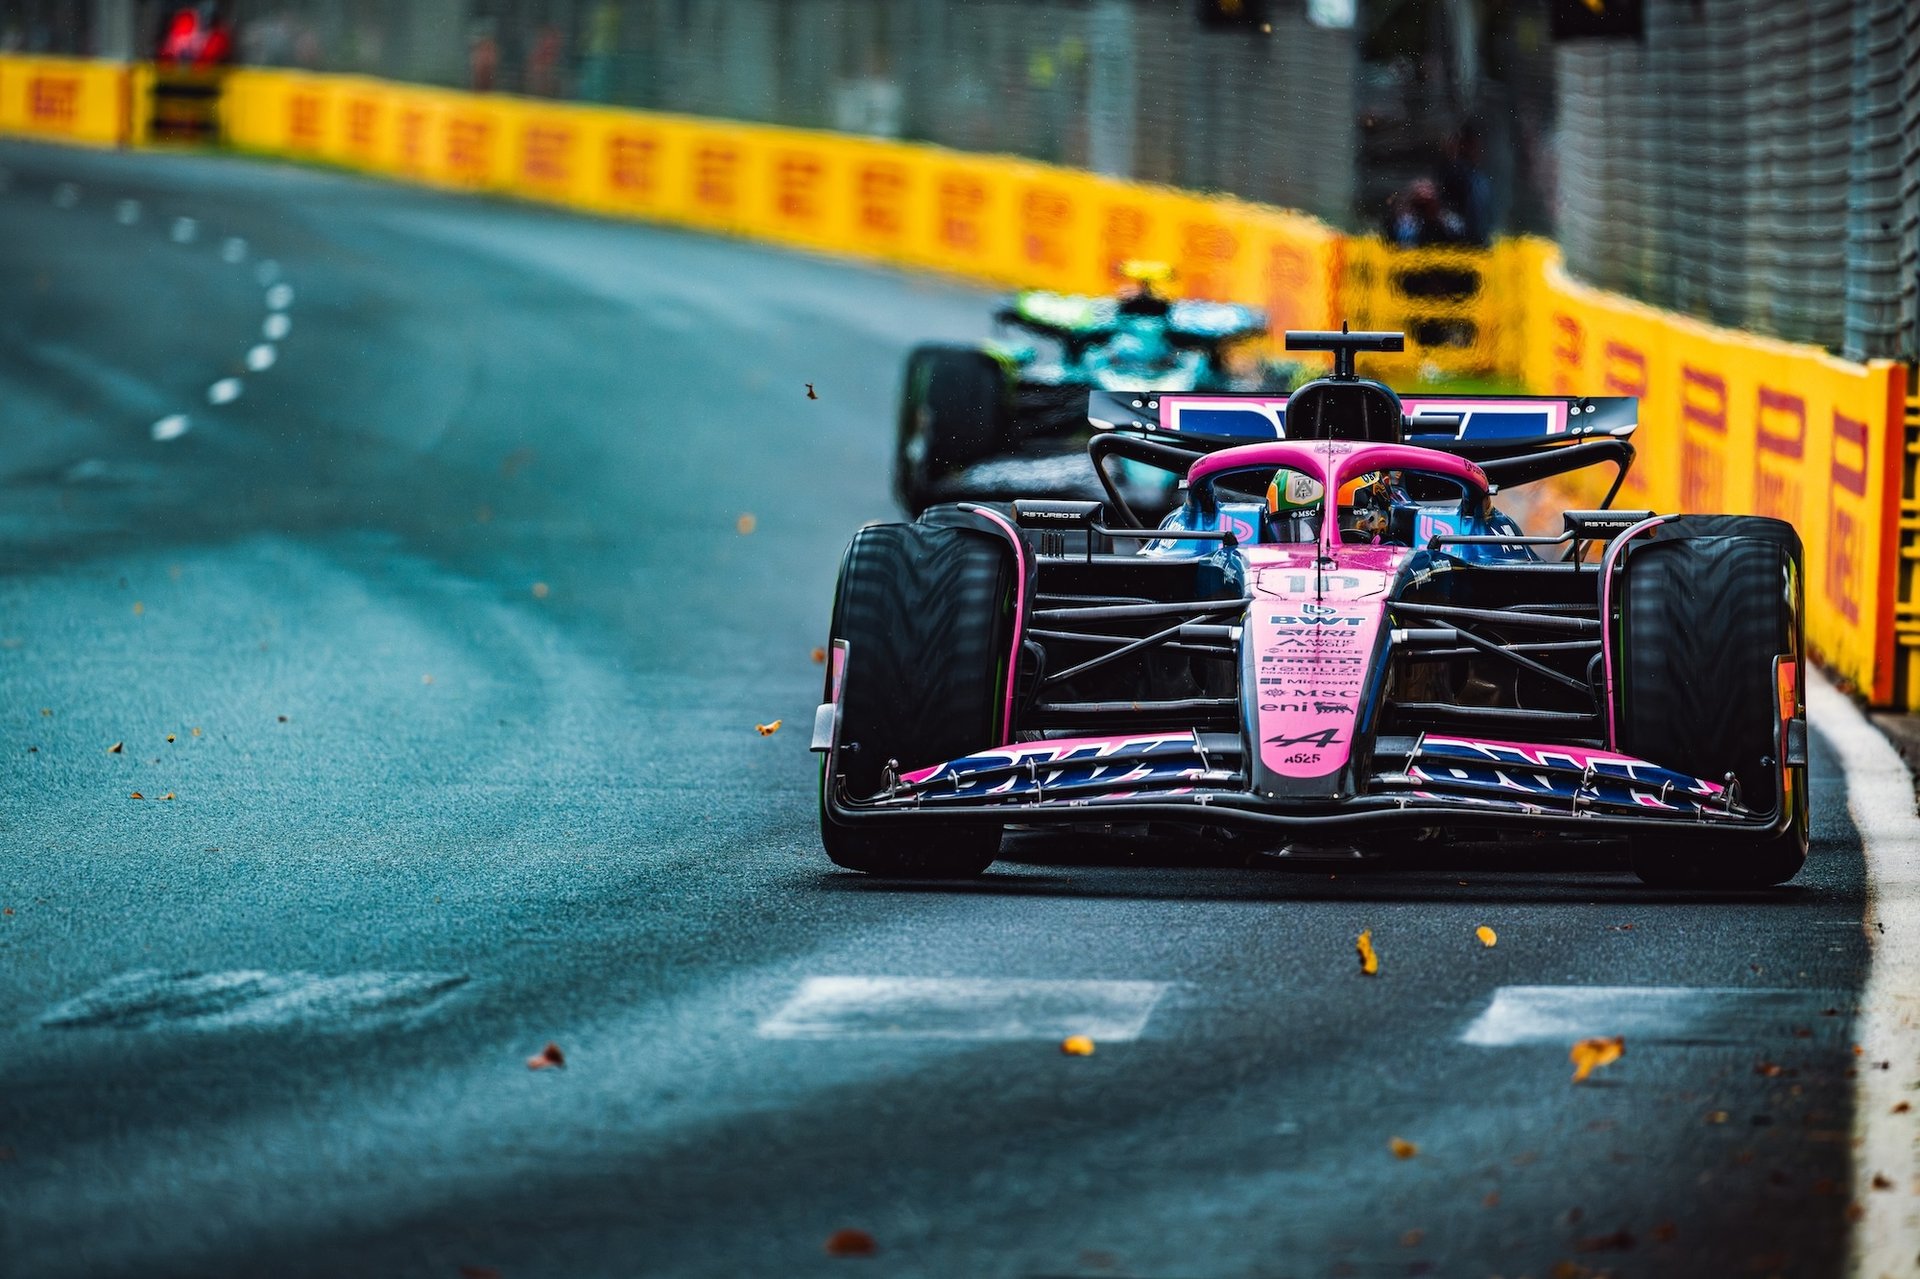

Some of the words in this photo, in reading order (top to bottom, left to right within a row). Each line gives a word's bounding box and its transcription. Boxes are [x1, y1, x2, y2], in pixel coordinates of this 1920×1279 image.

[1297, 509, 1316, 518] MSC
[1270, 615, 1366, 626] BWT
[1287, 678, 1361, 686] Microsoft
[1294, 689, 1359, 698] MSC
[1260, 701, 1308, 712] eni
